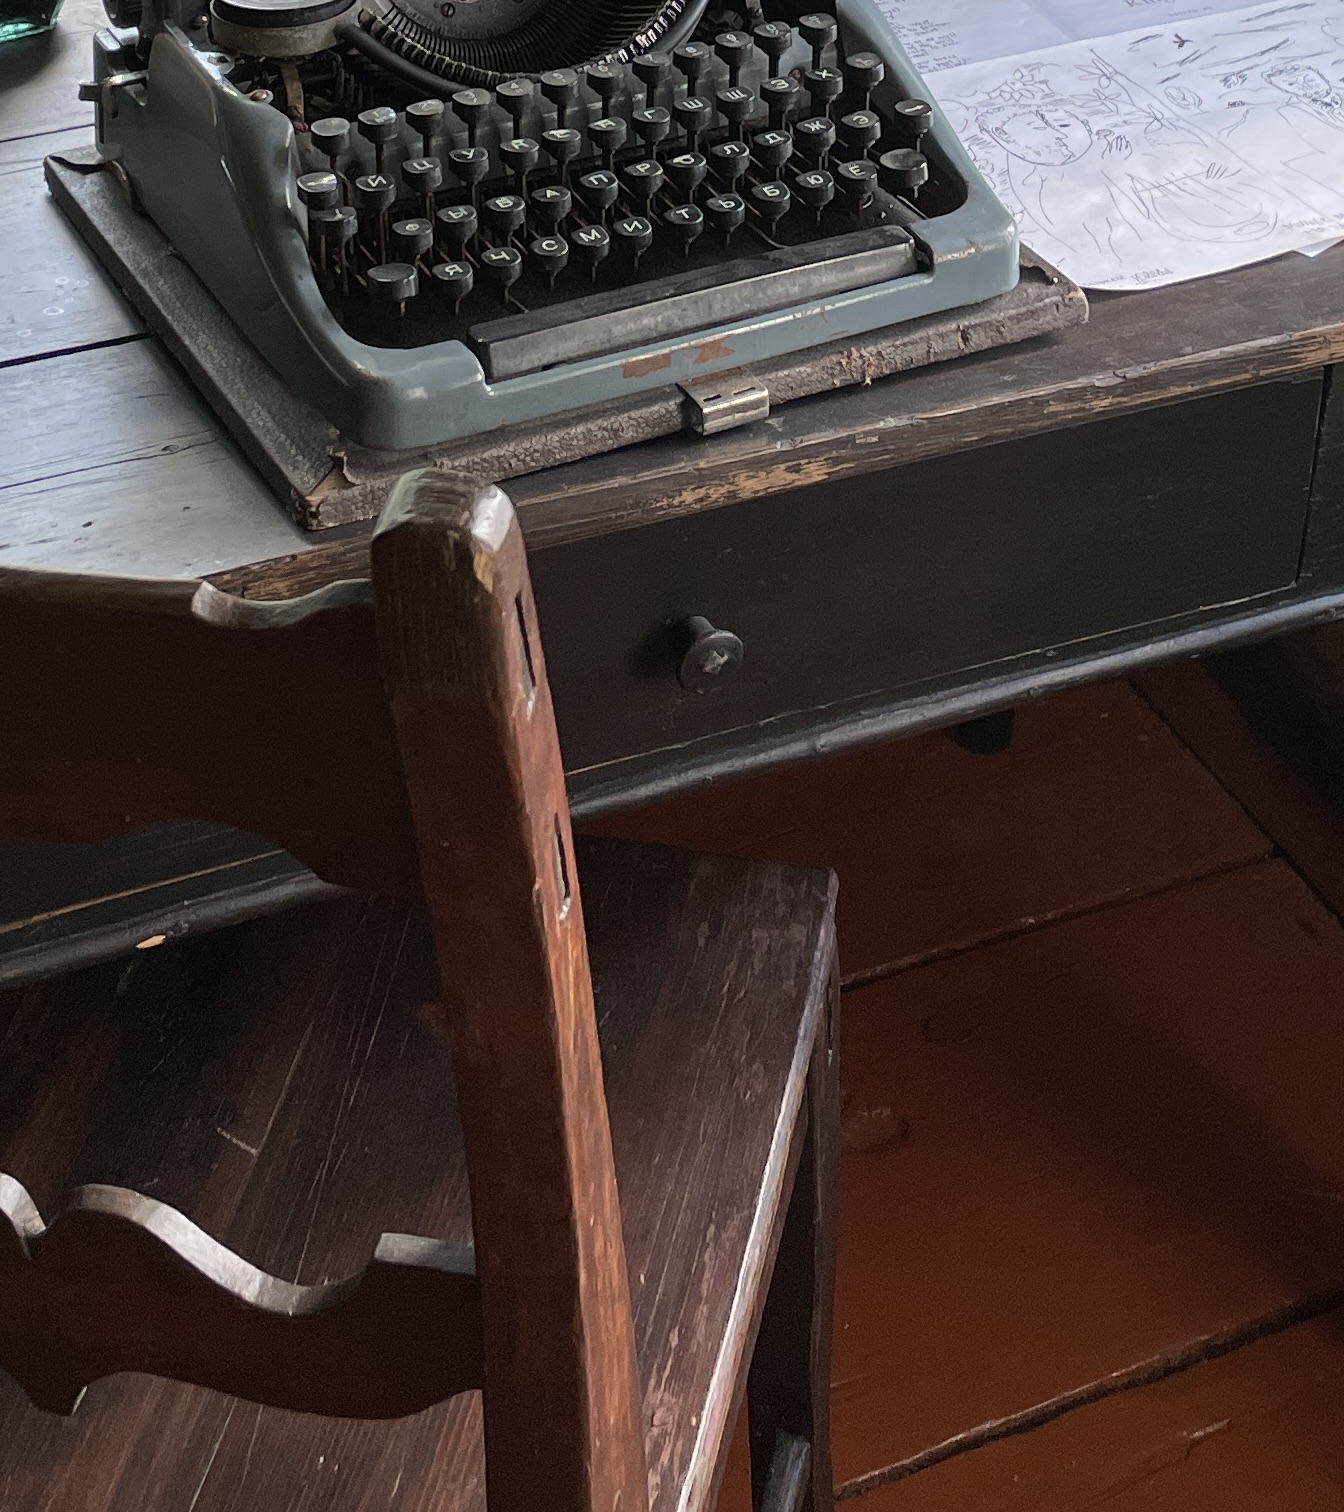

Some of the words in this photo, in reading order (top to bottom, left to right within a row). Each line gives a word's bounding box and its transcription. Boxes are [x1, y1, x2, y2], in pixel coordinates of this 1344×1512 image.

[588, 173, 608, 186] П
[635, 163, 651, 173] Р
[445, 264, 463, 277] Я
[490, 250, 511, 261] Ч
[541, 239, 559, 251] С
[579, 229, 602, 243] М
[623, 220, 643, 233] И
[675, 208, 690, 220] Т
[717, 199, 736, 209] Ь
[762, 186, 781, 197] Б
[806, 173, 824, 185] Ю
